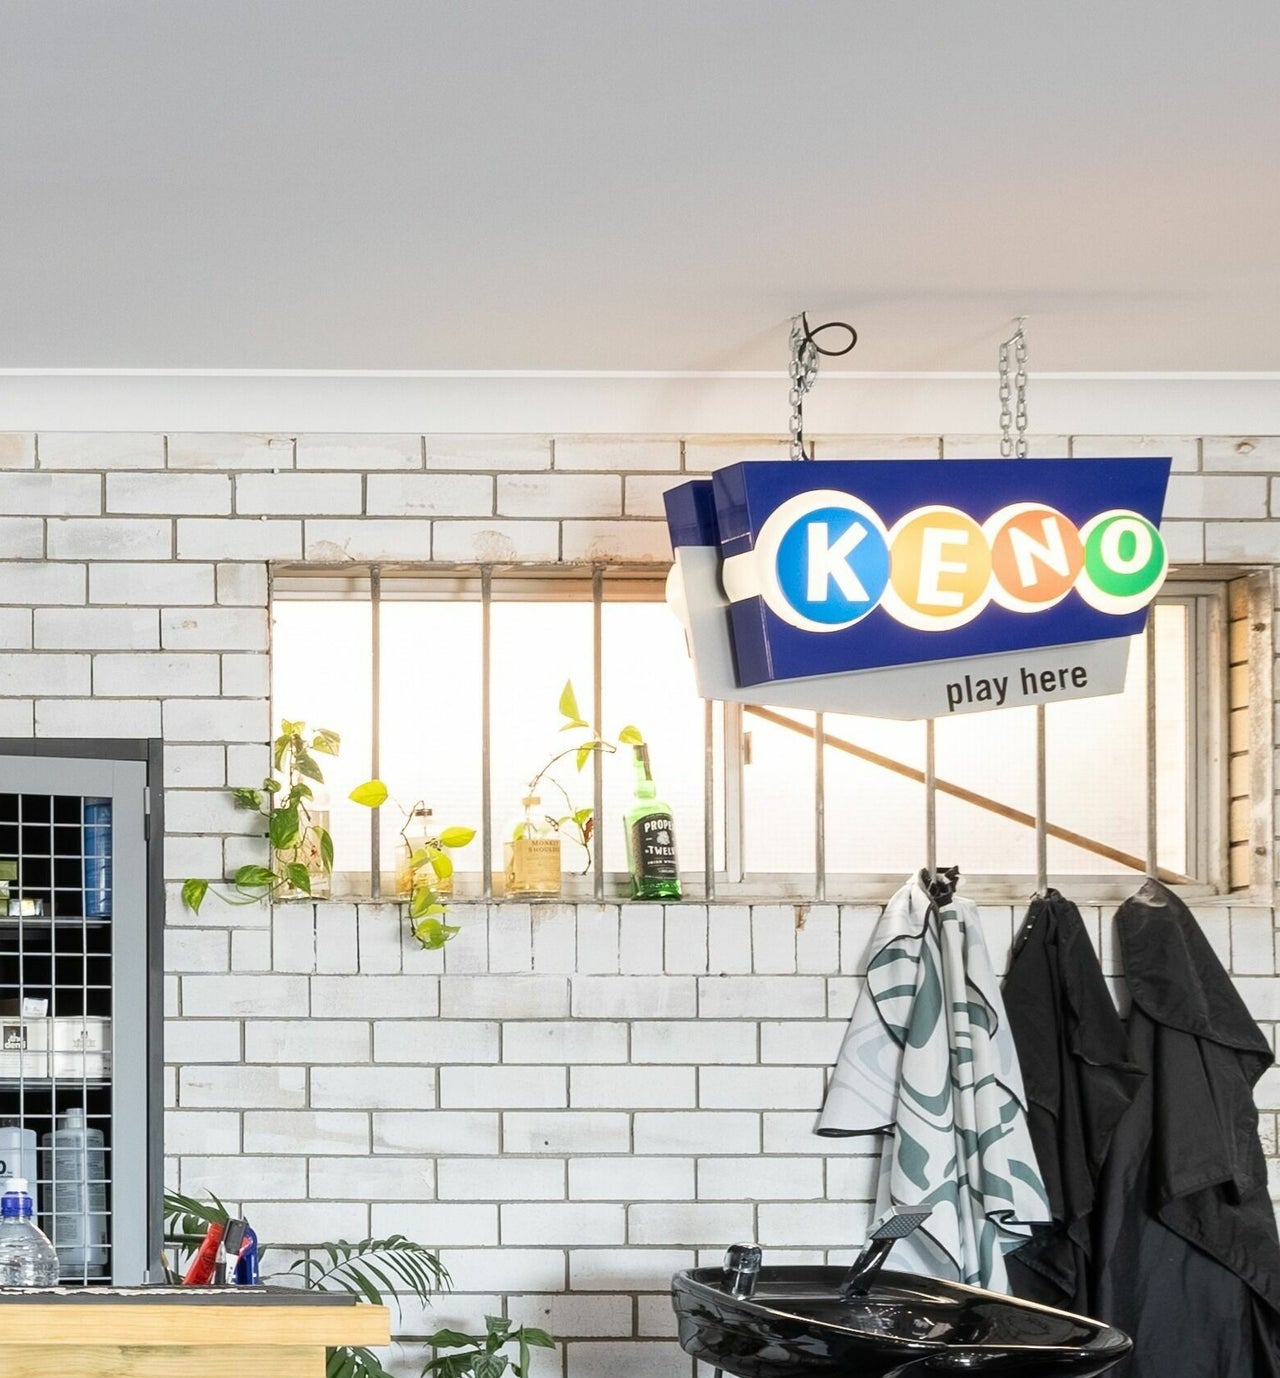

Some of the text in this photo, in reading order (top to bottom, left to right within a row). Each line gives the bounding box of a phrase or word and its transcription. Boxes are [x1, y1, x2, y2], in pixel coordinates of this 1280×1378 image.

[806, 516, 1153, 606] KENO
[945, 664, 1089, 712] play here
